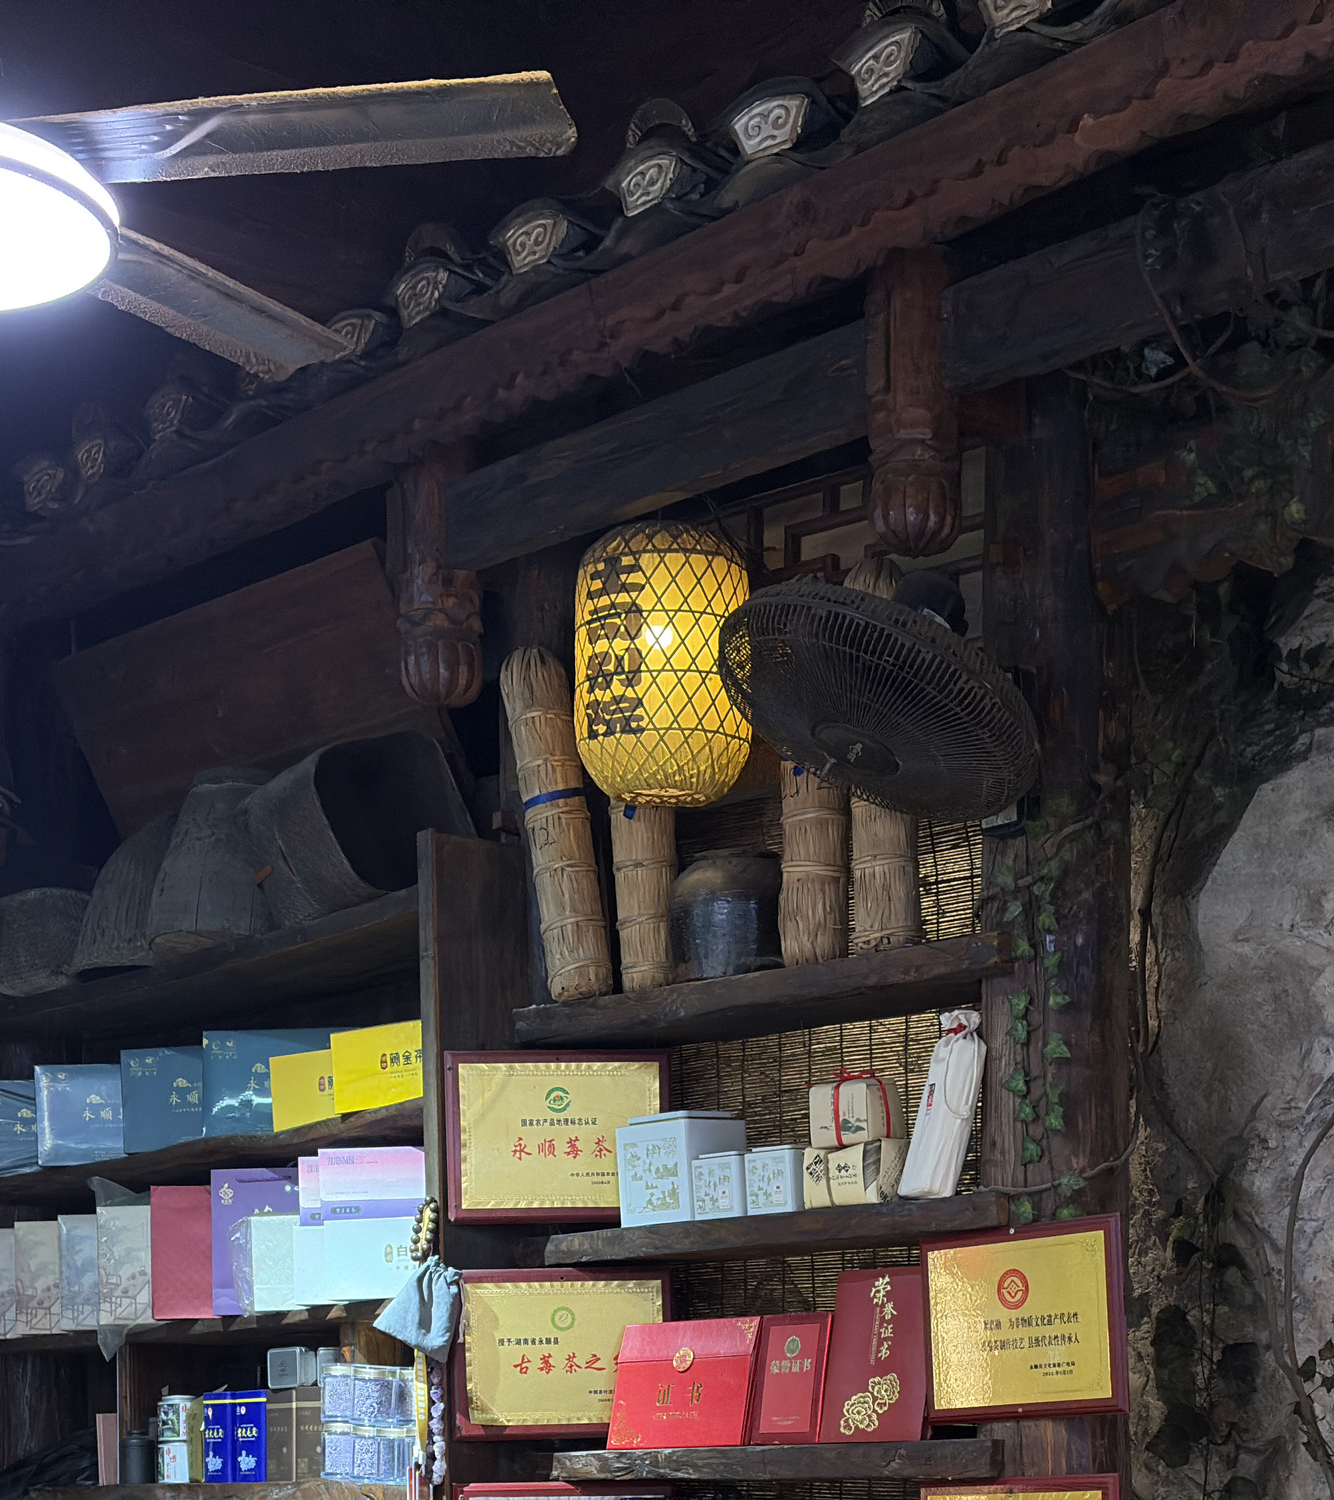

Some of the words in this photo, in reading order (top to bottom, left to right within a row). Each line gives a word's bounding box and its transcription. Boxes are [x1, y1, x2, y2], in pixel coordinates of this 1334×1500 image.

[82, 1106, 124, 1121] 永顺
[520, 1117, 599, 1128] 国家农产品地理标志认证
[511, 1135, 614, 1162] 永顺莓茶
[870, 1273, 899, 1362] 荣誉证书
[512, 1351, 620, 1376] 古莓茶之
[656, 1381, 704, 1407] 证书
